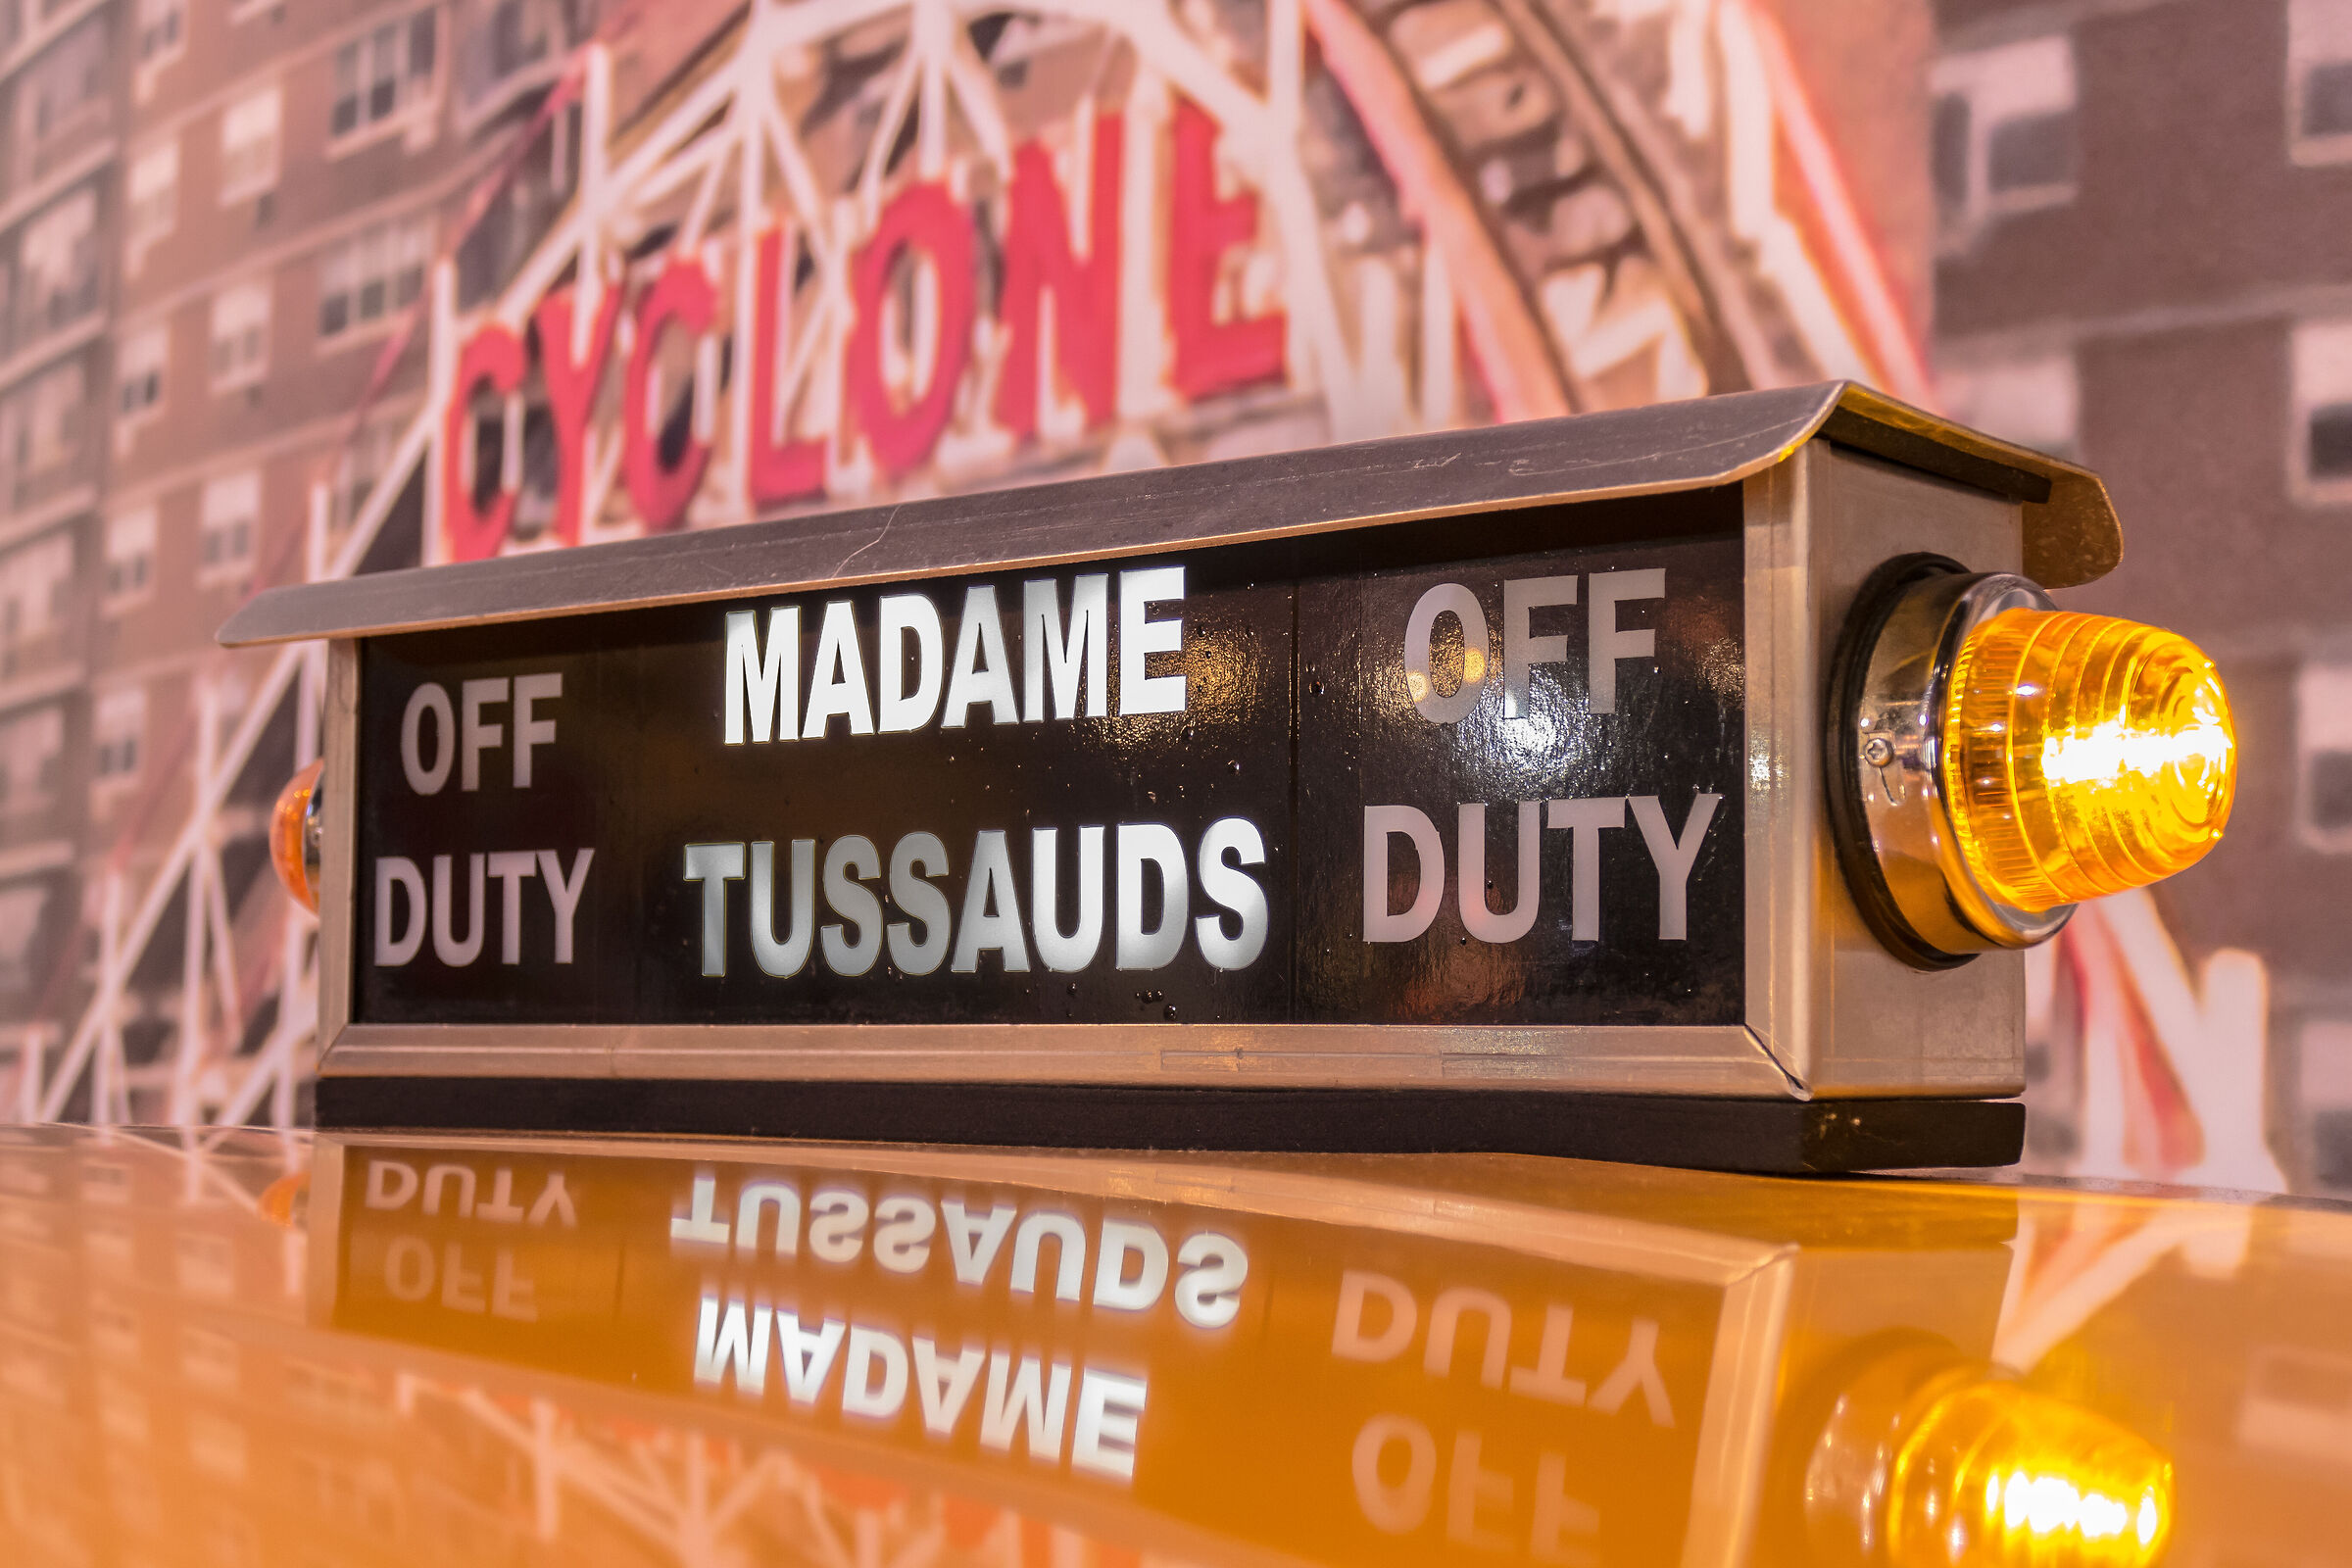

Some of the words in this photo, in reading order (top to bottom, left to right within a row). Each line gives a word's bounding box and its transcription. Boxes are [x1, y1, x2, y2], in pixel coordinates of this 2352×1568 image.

[442, 98, 1290, 562] CYCLONE
[723, 565, 1188, 746] MADAME
[1403, 567, 1666, 725] OFF
[400, 672, 563, 796] OFF
[373, 848, 595, 969] DUTY
[683, 817, 1269, 978] TUSSAUDS
[1363, 791, 1723, 945] DUTY
